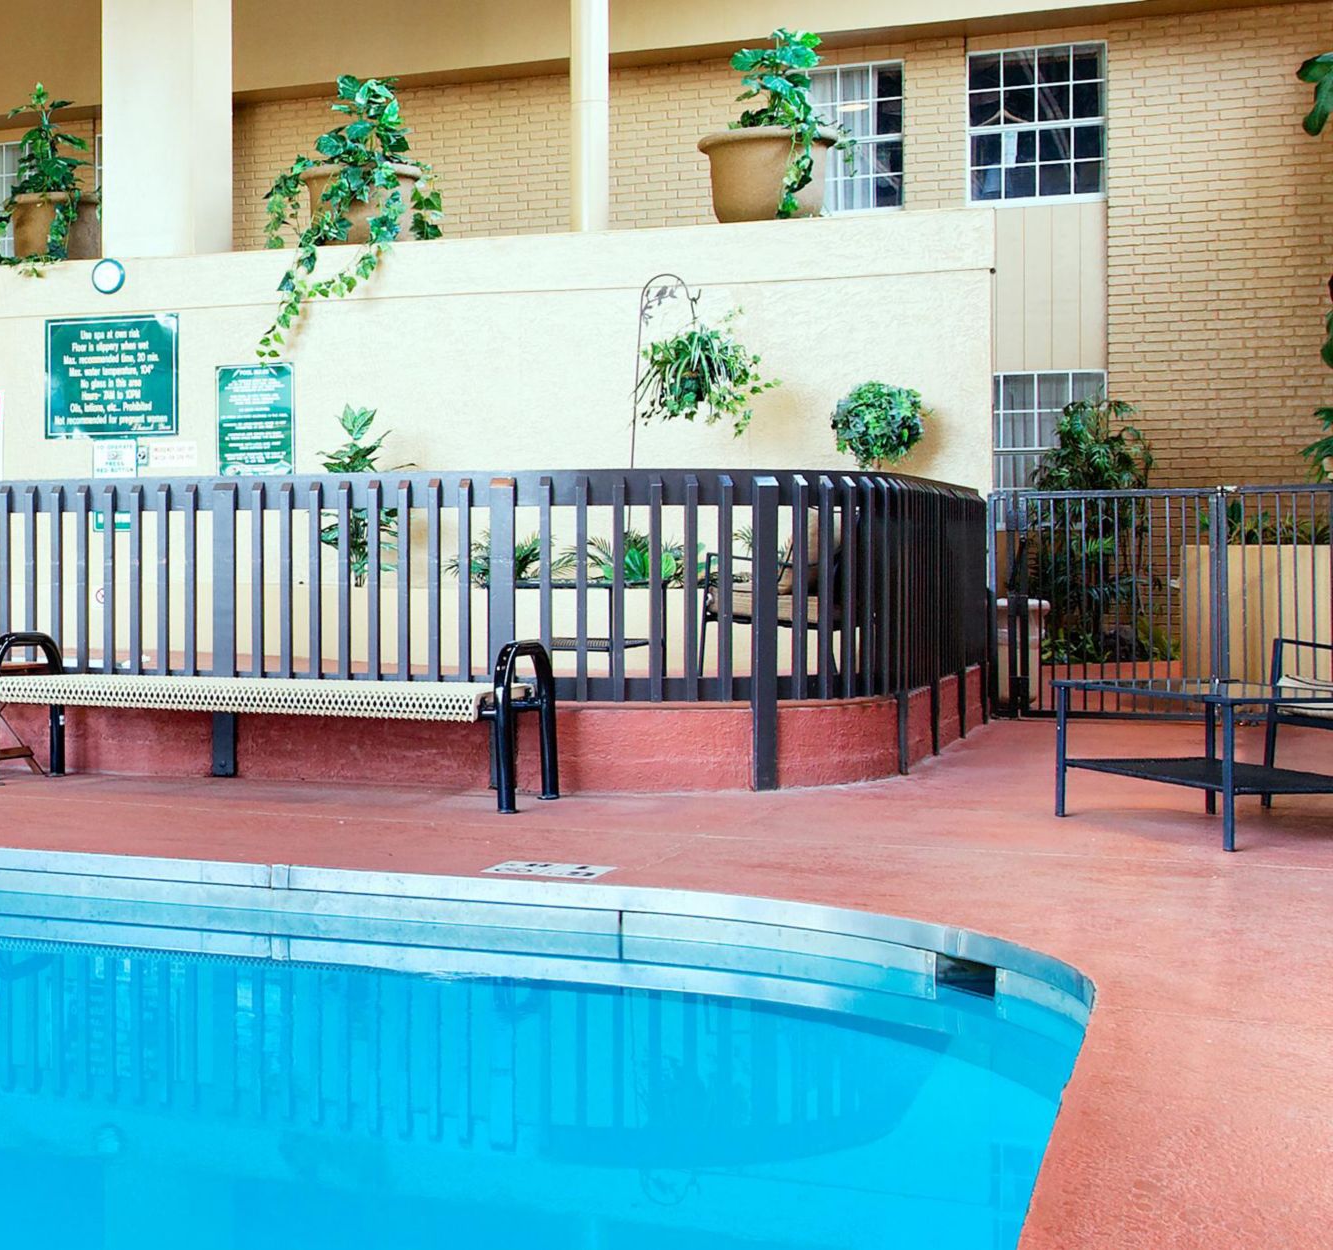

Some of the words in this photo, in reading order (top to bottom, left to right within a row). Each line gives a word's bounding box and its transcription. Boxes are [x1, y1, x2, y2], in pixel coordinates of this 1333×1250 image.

[80, 330, 92, 340] Use
[94, 331, 105, 341] spa
[107, 330, 113, 339] at
[114, 331, 127, 339] own
[129, 328, 140, 339] risk
[72, 342, 87, 352] Floor
[88, 341, 94, 352] is
[96, 341, 119, 353] slippery
[121, 340, 136, 350] when
[138, 340, 149, 350] wet
[78, 354, 119, 364] recommended
[137, 352, 146, 362] 20
[84, 366, 101, 376] water
[80, 379, 89, 389] No
[90, 378, 106, 390] glass
[108, 378, 114, 388] in
[115, 377, 127, 388] this
[128, 379, 142, 387] area
[103, 390, 115, 400] 7AM
[117, 390, 124, 400] to
[125, 389, 141, 399] 10PM
[123, 400, 152, 411] Prohibited
[54, 415, 65, 425] Not
[67, 414, 107, 425] recommended
[108, 414, 117, 424] for
[119, 414, 145, 426] pregnant
[146, 415, 168, 423] women
